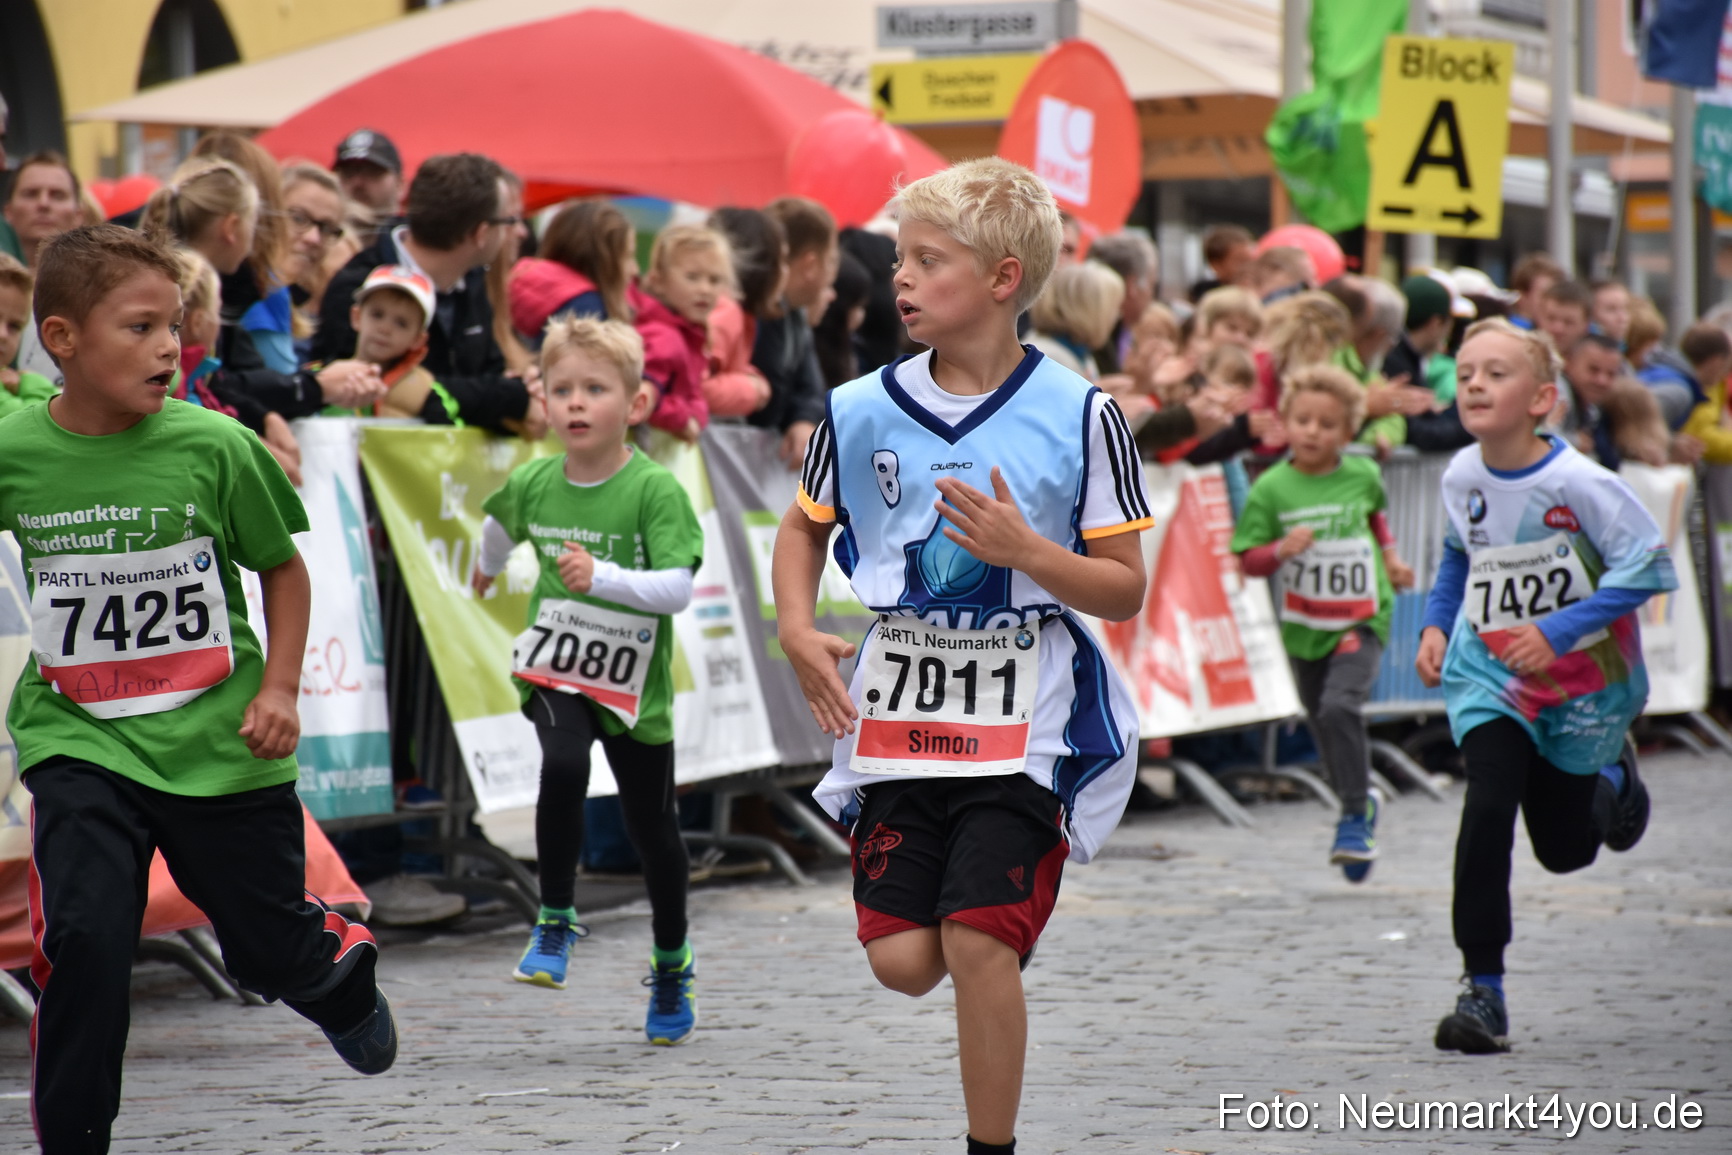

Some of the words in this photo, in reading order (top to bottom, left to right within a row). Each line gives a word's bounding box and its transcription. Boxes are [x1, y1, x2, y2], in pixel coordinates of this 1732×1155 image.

[885, 11, 1038, 44] Klostergasse
[1400, 45, 1500, 83] Block
[1402, 96, 1472, 191] A
[17, 504, 142, 530] Neumarkter
[27, 528, 117, 553] Stadtlauf
[39, 571, 96, 587] PARTL
[101, 561, 190, 585] Neumarkt
[1291, 560, 1367, 595] 7160
[1498, 553, 1553, 572] Neumarkt
[1474, 567, 1581, 626] 7422
[50, 582, 210, 657] 7425
[568, 614, 633, 640] Neumarkt
[213, 632, 221, 644] K
[875, 626, 921, 647] PARTL
[924, 633, 1008, 650] Neumarkt
[525, 625, 638, 686] 7080
[72, 669, 174, 700] Adrian
[884, 651, 1016, 716] 7011
[908, 729, 979, 755] Simon
